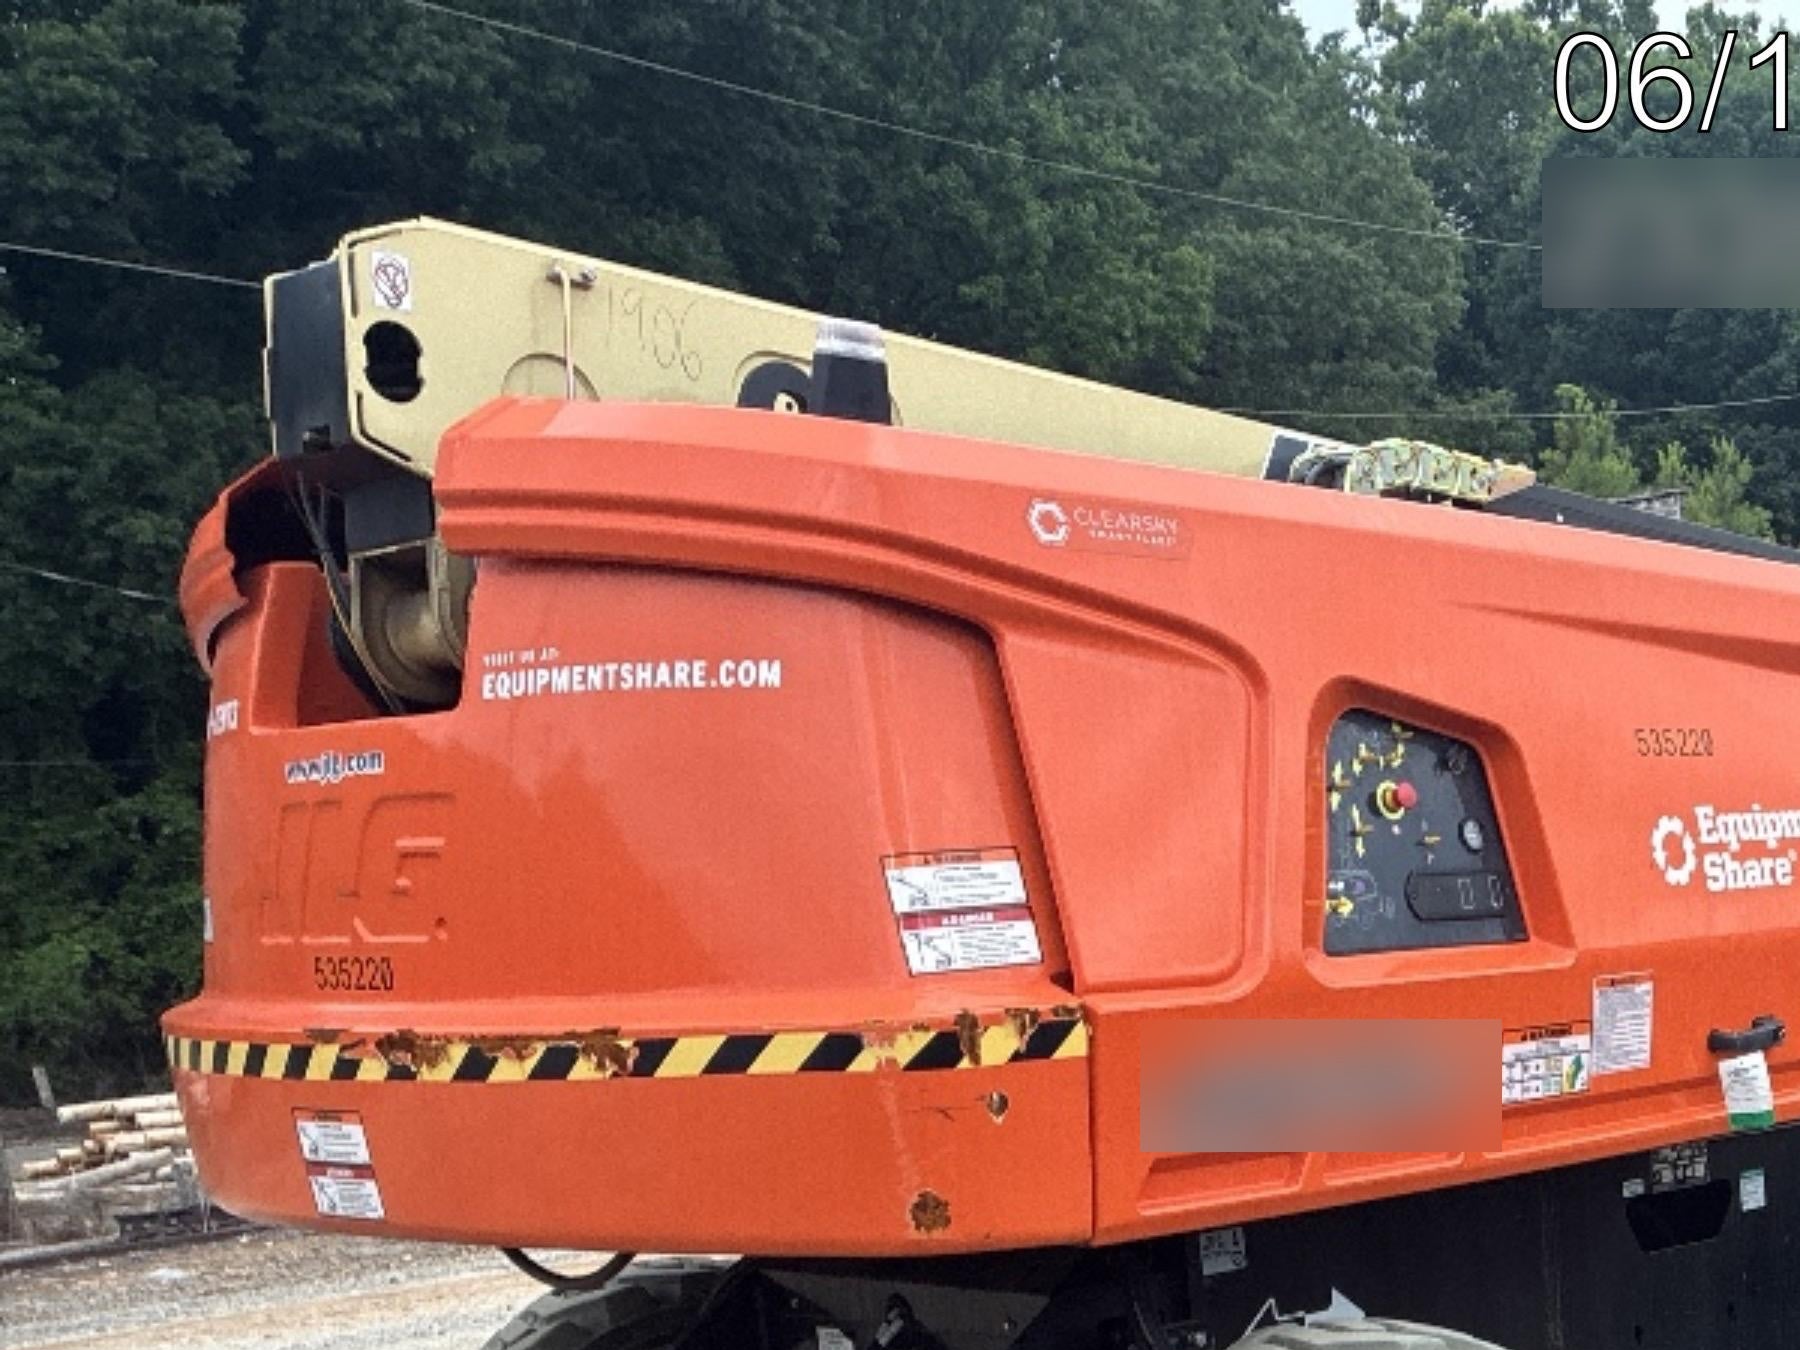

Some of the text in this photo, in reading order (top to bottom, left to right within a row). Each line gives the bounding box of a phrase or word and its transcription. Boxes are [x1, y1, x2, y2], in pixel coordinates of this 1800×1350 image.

[606, 286, 702, 381] 1906
[1073, 506, 1178, 535] CLEARSKY
[481, 659, 781, 700] EQUIPMENTSHARE.COM
[1634, 728, 1714, 757] 535220
[1703, 851, 1794, 892] Share
[314, 956, 394, 991] 535220
